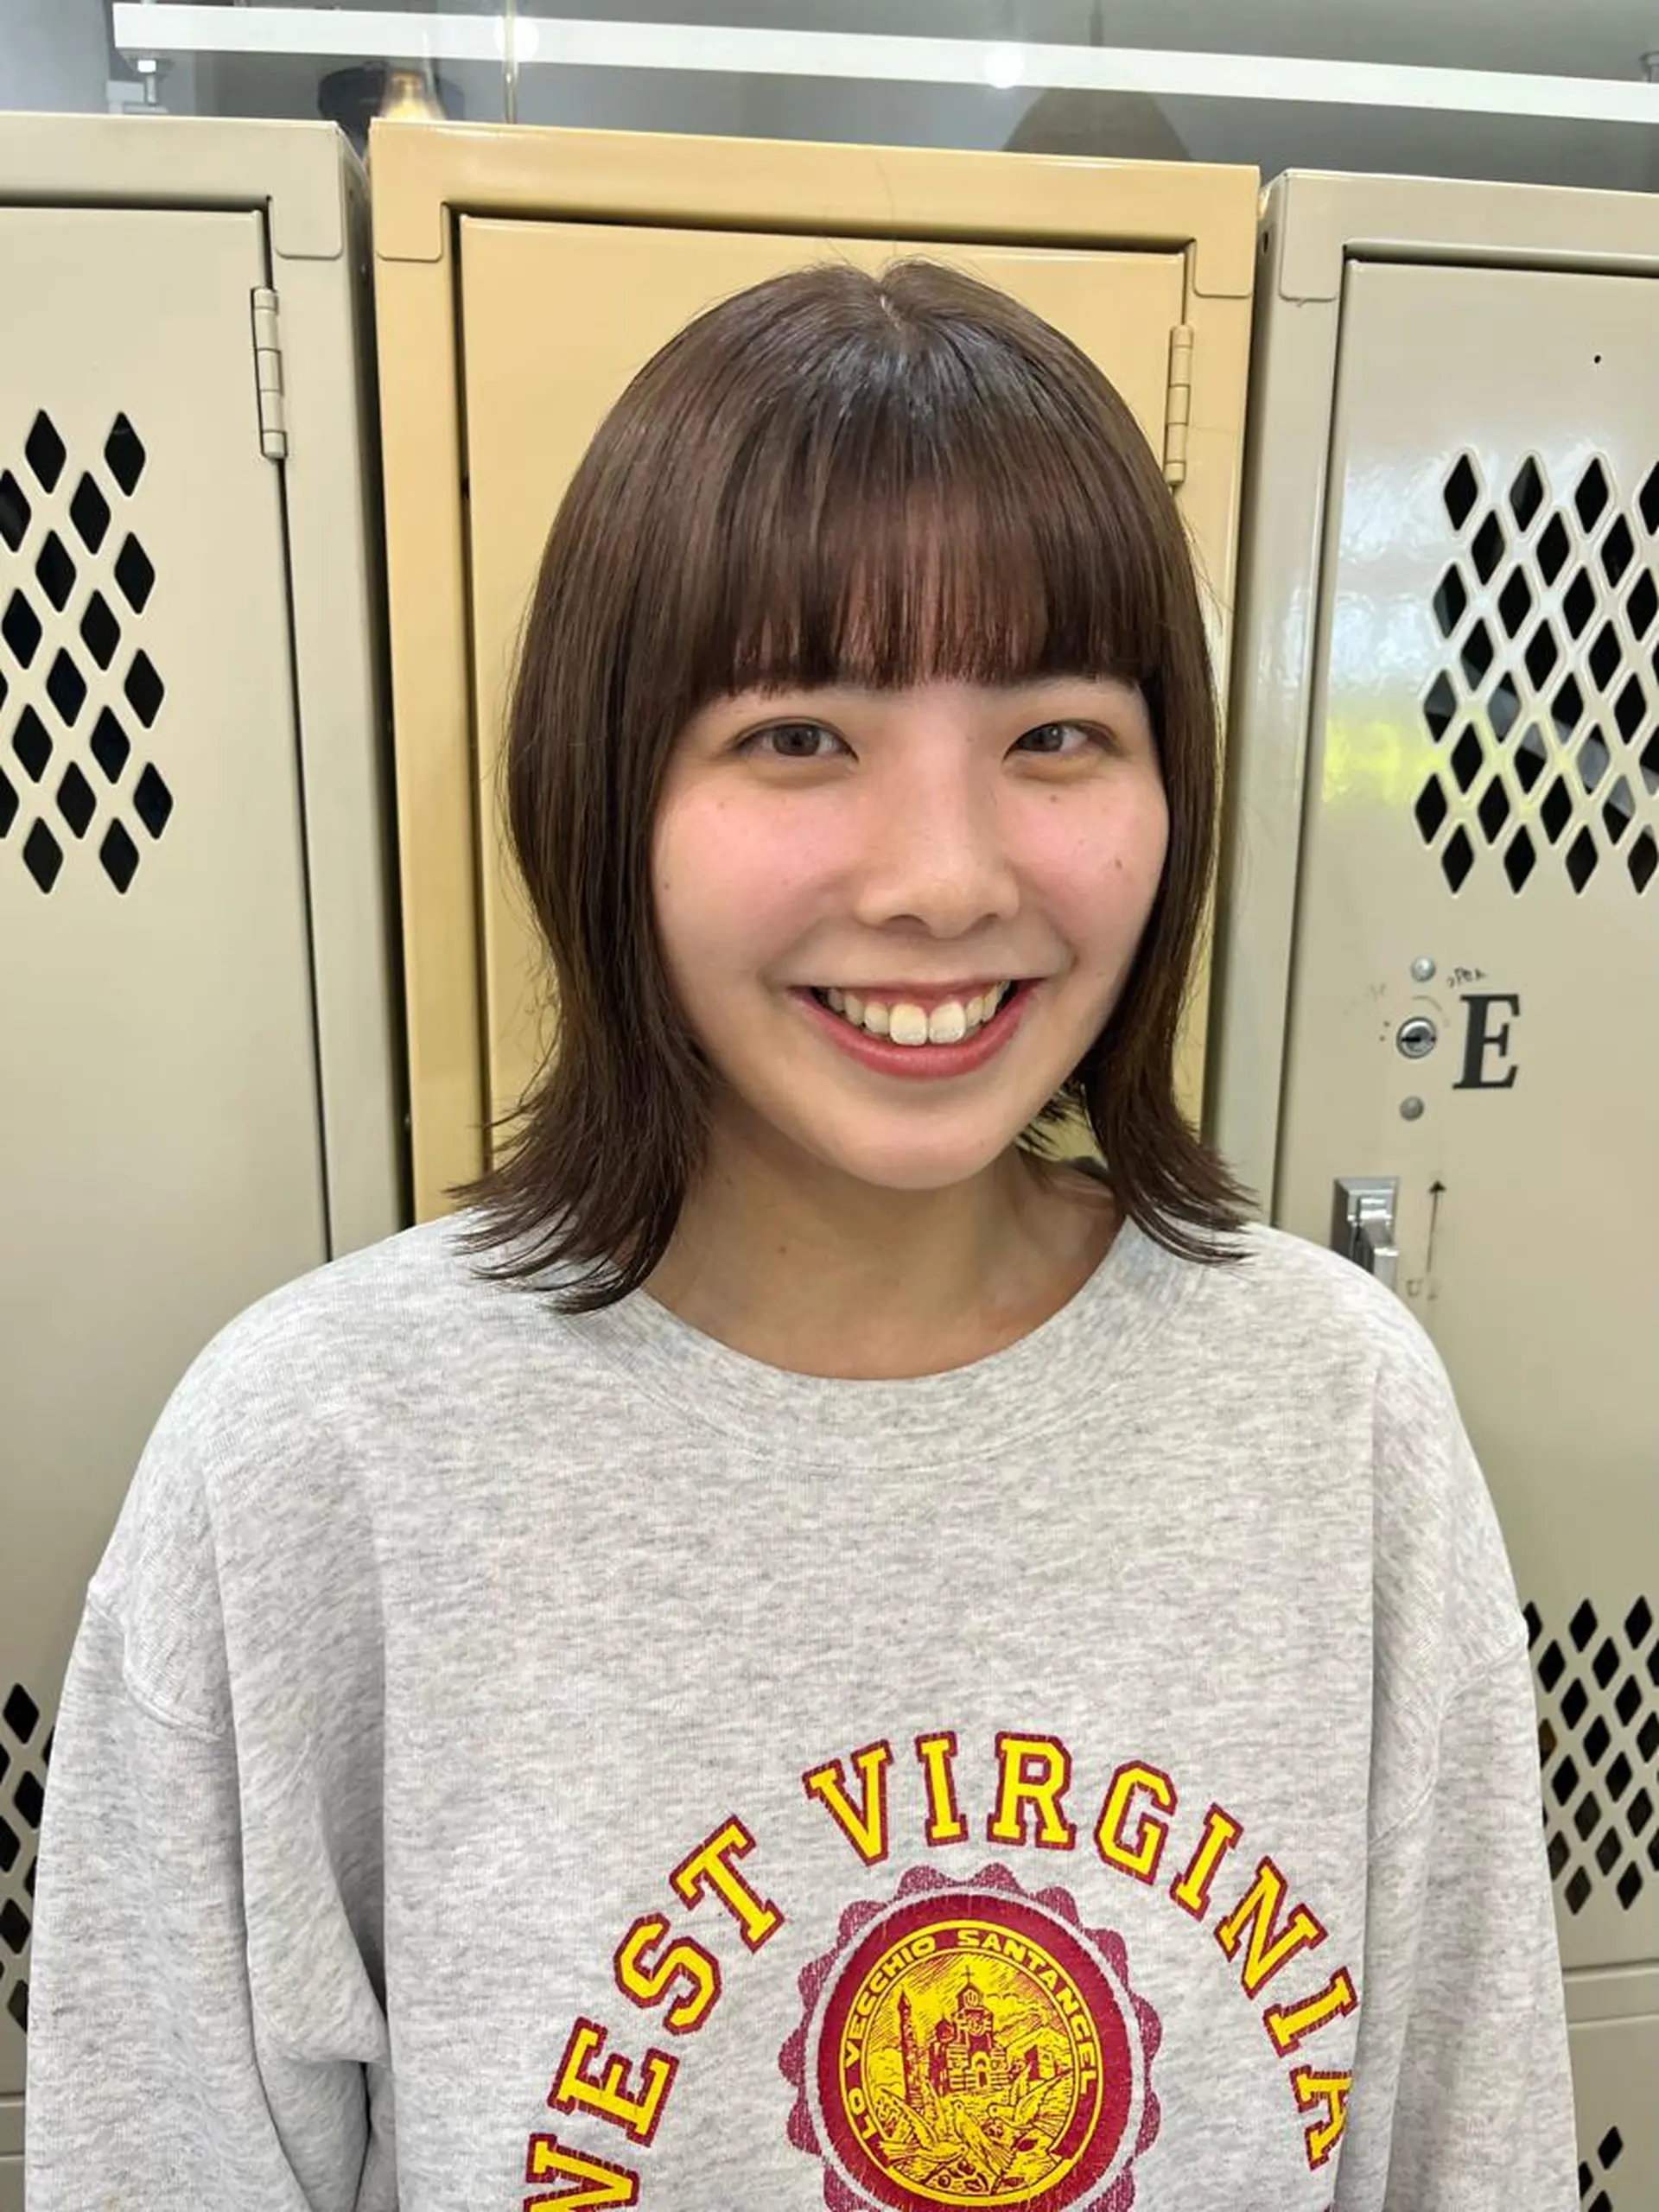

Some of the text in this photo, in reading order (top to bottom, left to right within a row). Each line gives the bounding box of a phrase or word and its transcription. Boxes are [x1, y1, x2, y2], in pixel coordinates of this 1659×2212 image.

[1452, 994, 1520, 1090] E
[802, 1731, 1357, 2171] VIRGINIA
[845, 1935, 936, 2069] VECCHIO
